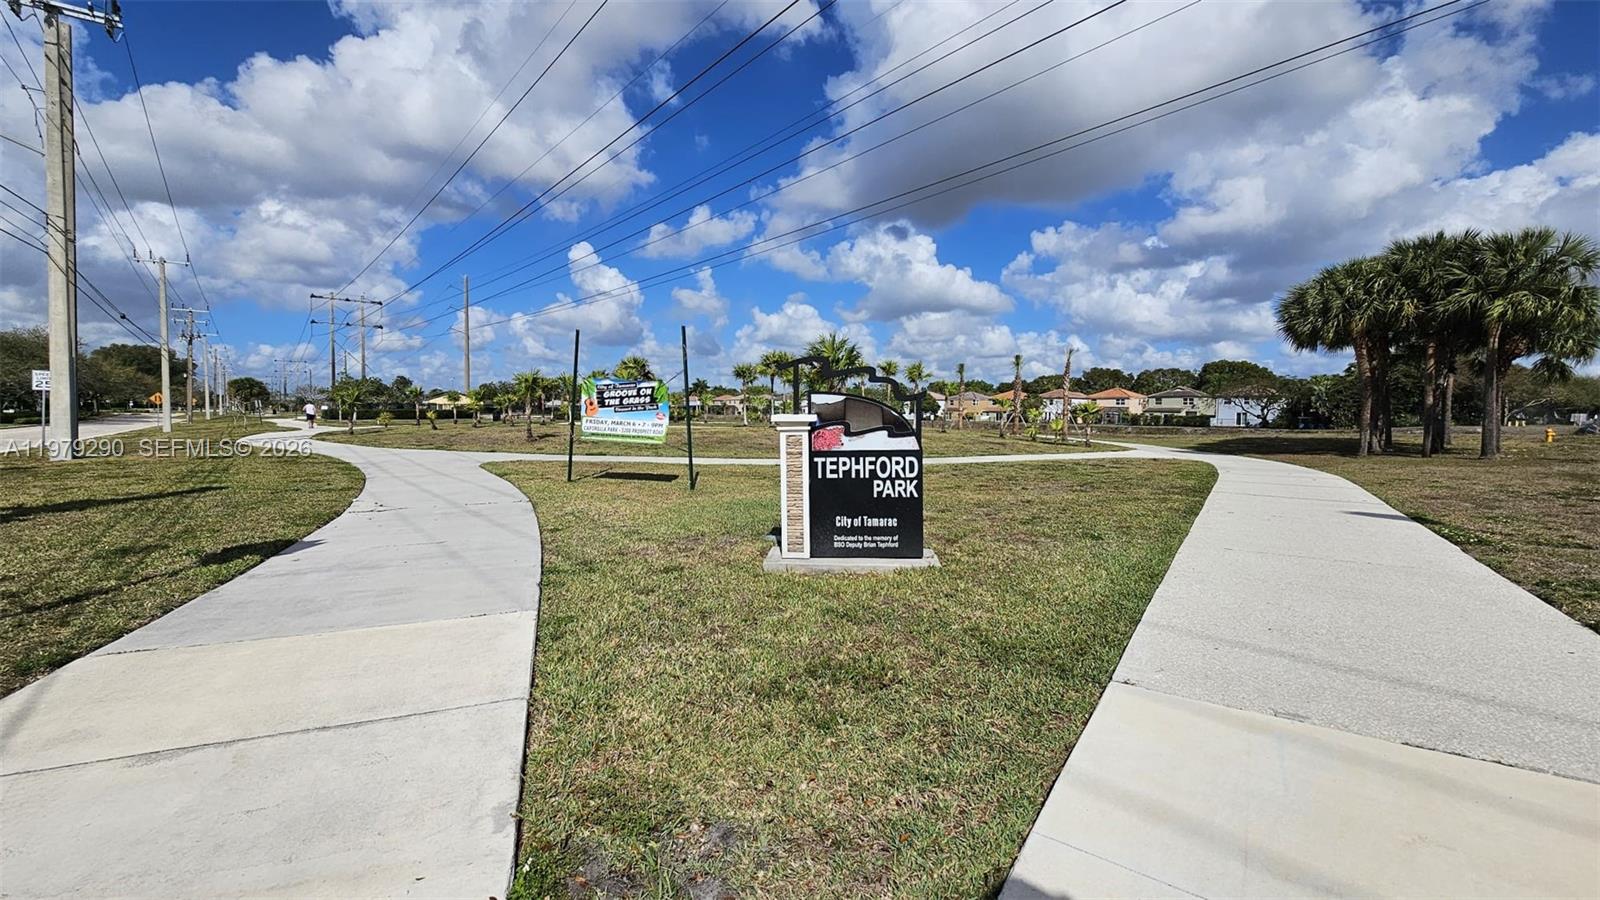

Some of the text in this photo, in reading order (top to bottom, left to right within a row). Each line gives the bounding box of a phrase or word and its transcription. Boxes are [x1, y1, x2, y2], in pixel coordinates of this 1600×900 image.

[35, 380, 51, 388] 25
[603, 389, 638, 398] GROOVE
[622, 396, 651, 405] GRASS
[814, 456, 918, 479] TEPHFORD
[873, 480, 918, 498] PARK
[836, 516, 898, 528] City of Tamarac
